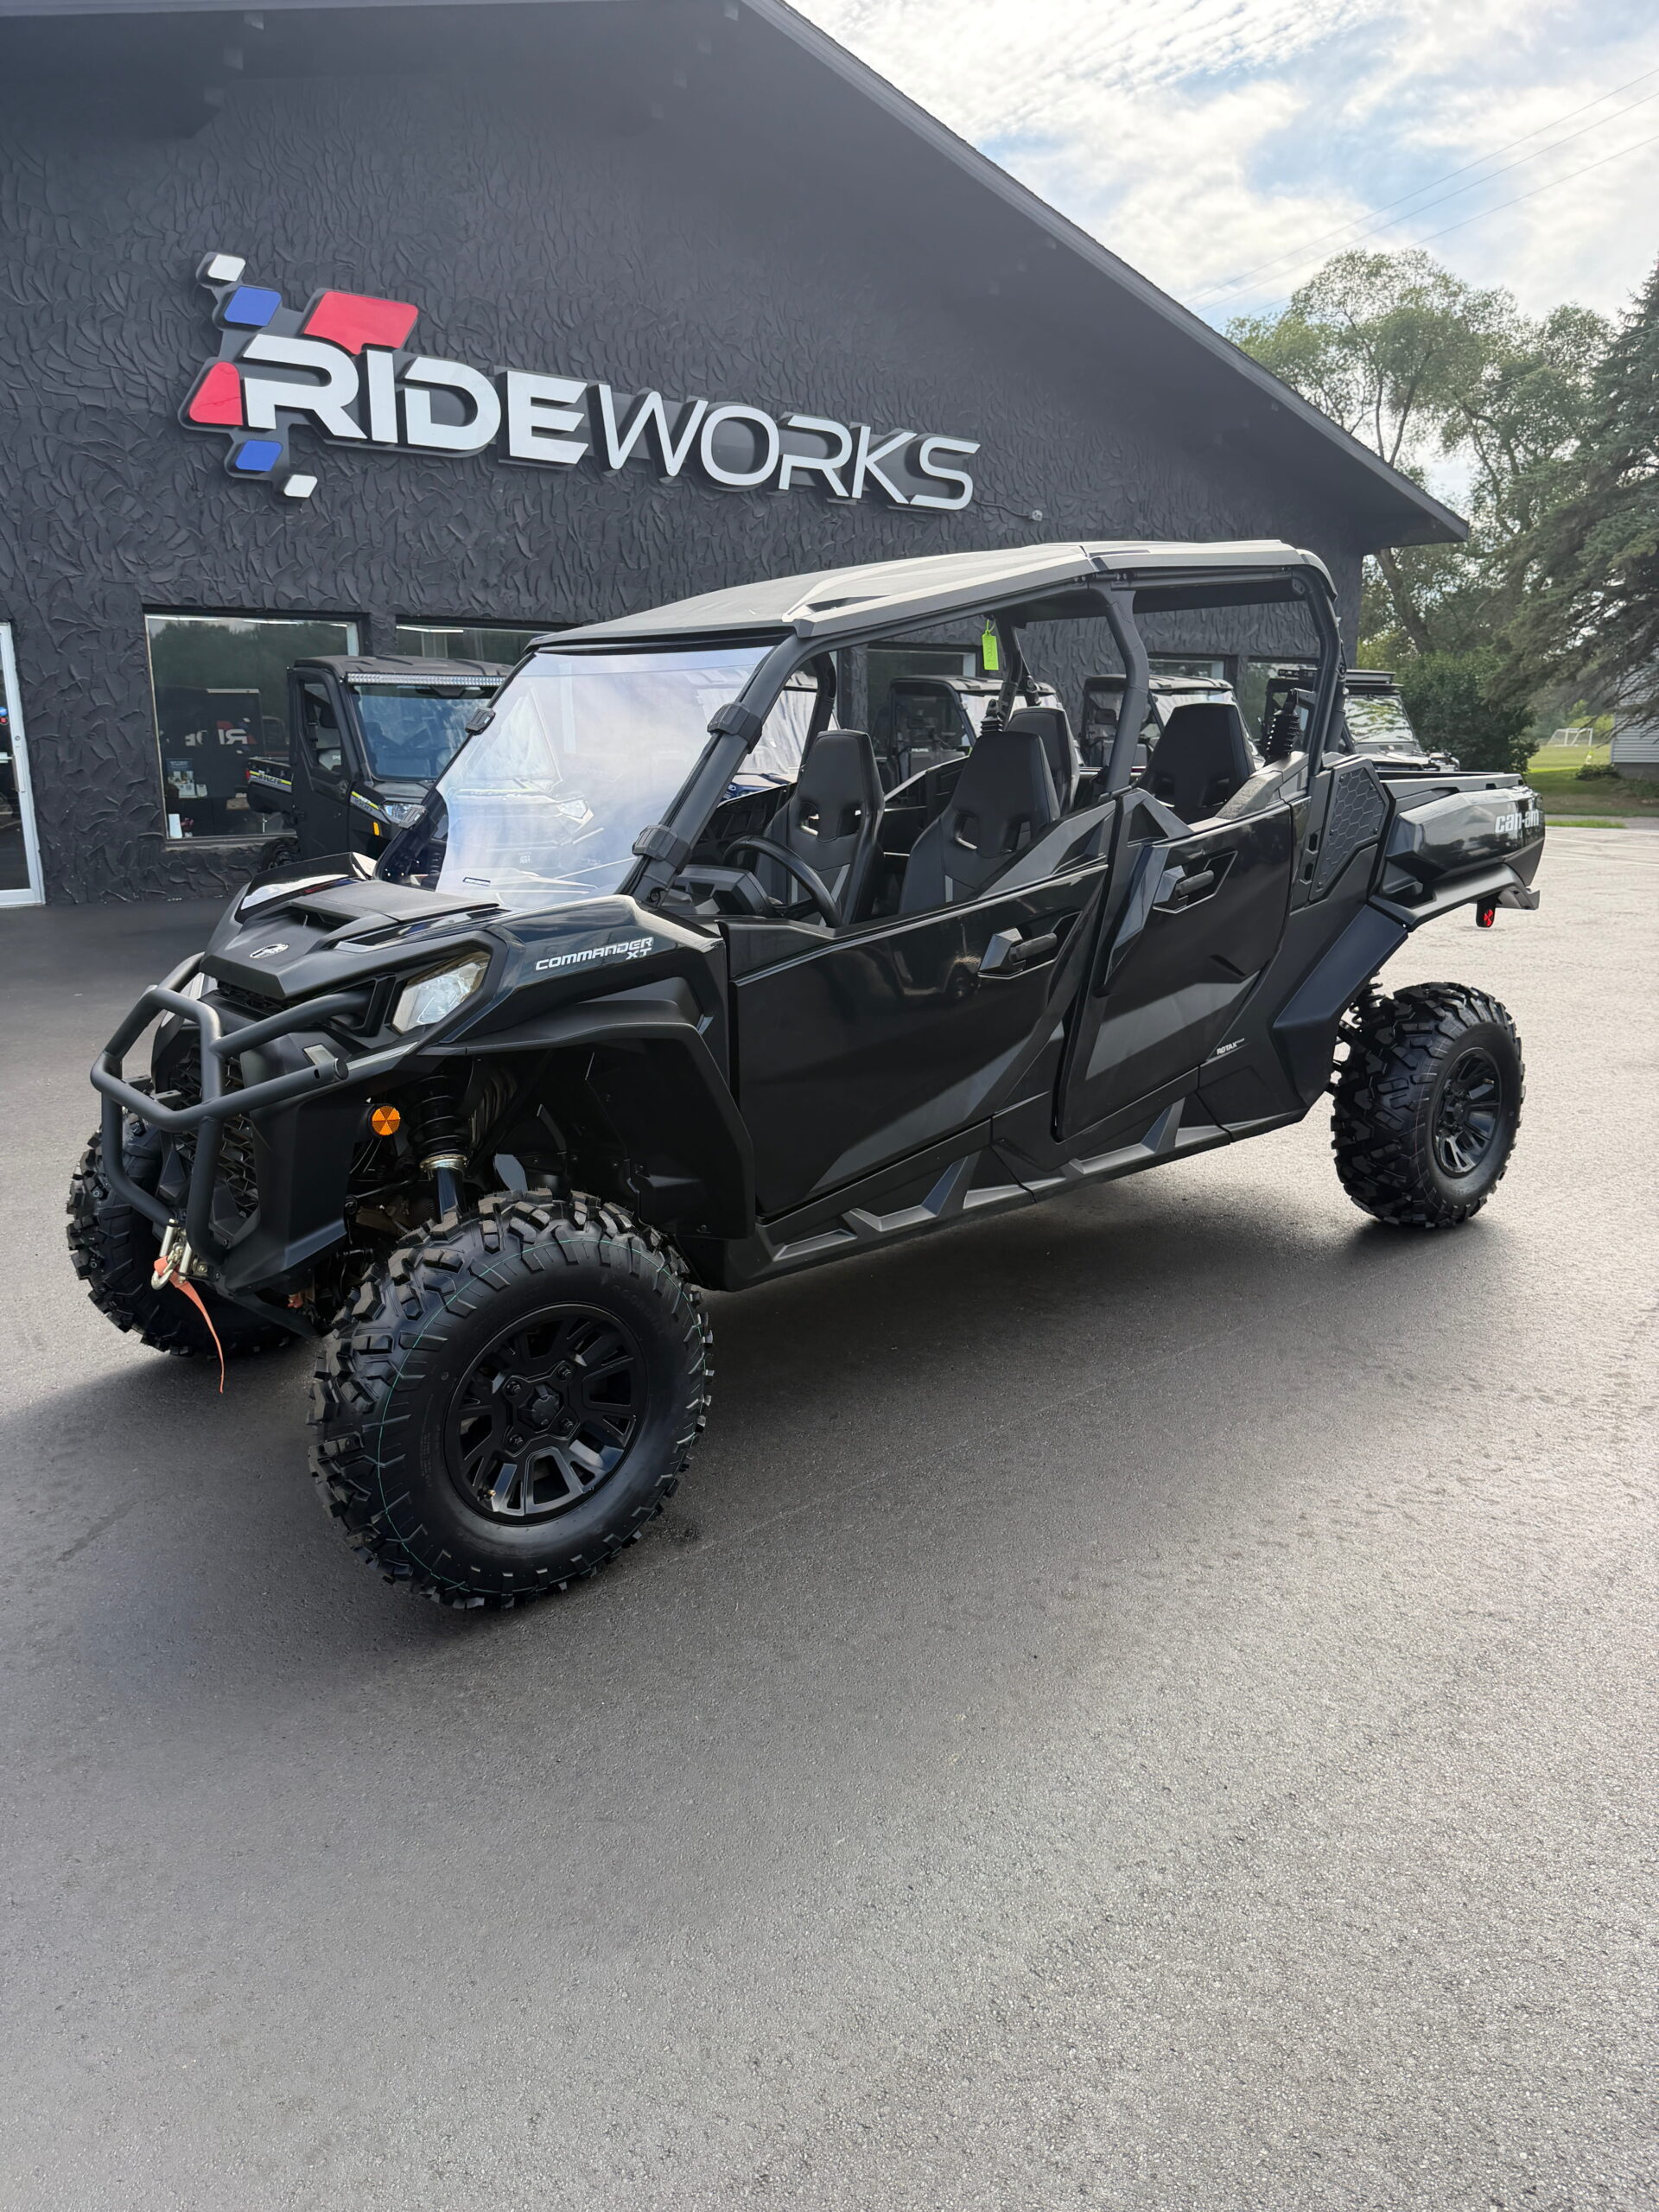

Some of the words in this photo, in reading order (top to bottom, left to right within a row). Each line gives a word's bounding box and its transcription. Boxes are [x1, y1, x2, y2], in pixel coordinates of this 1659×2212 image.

[243, 334, 981, 510] RIDEWORKS
[535, 936, 654, 970] COMMANDER
[625, 947, 652, 961] XT
[1217, 1042, 1237, 1055] ROTAX
